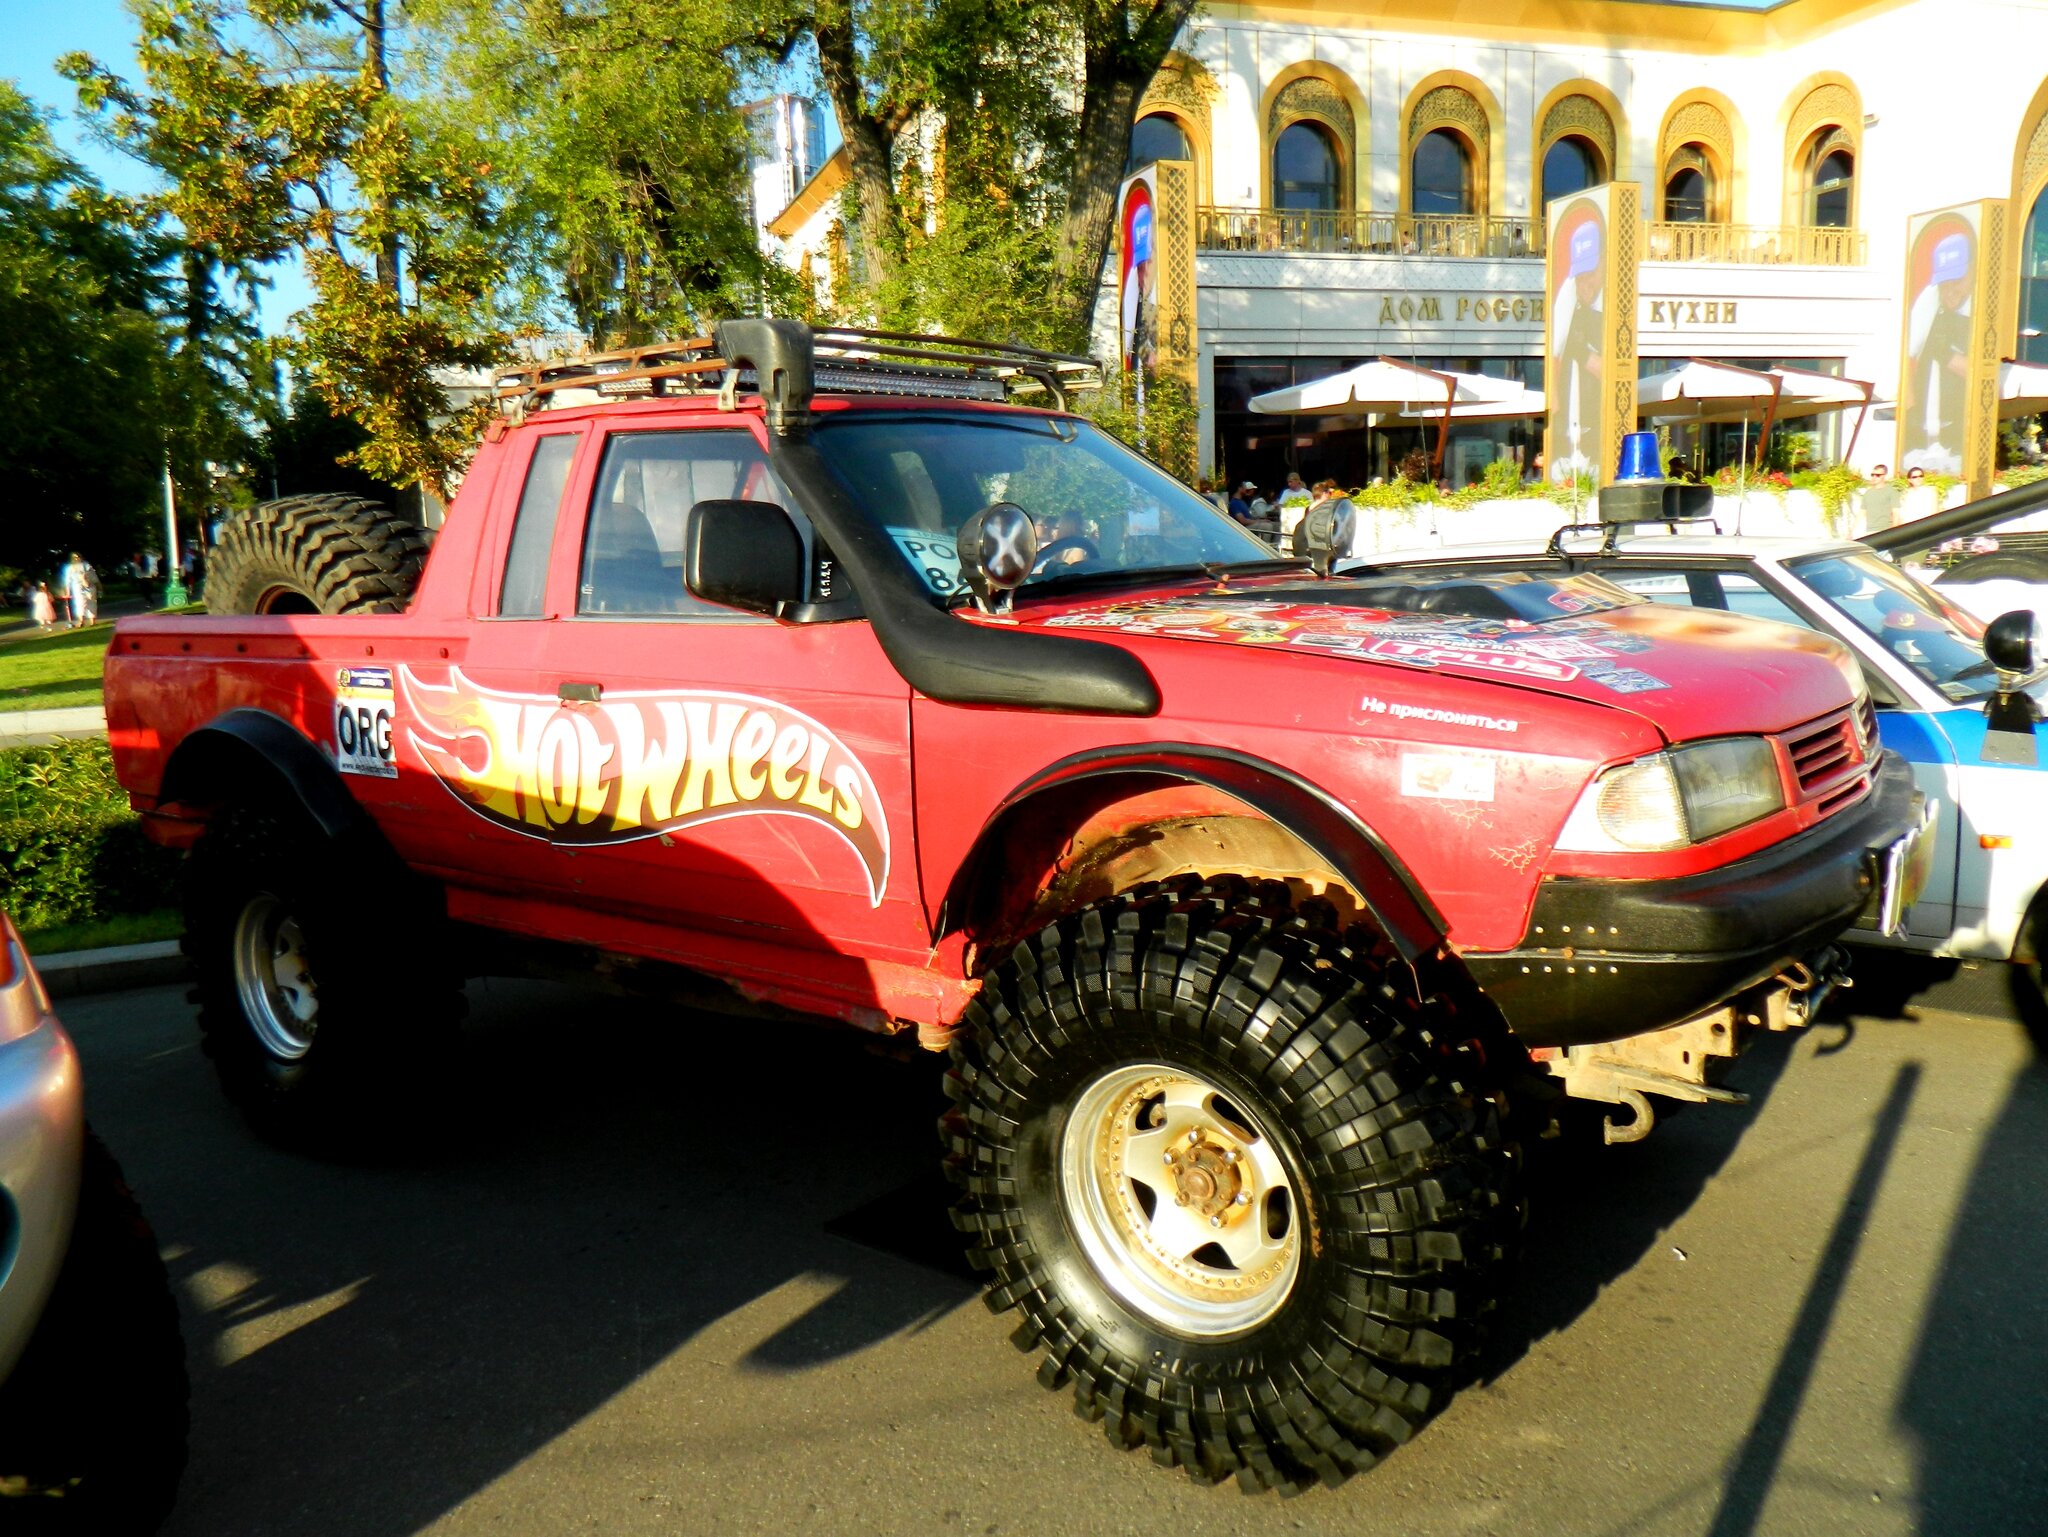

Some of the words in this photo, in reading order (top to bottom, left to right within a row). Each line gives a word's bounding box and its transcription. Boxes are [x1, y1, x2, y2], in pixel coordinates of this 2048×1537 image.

[1379, 297, 1443, 324] ДОМ
[1650, 301, 1738, 329] КУХНИ
[1361, 697, 1387, 713] Не
[1390, 703, 1519, 732] прислоняться
[338, 706, 392, 759] ORG
